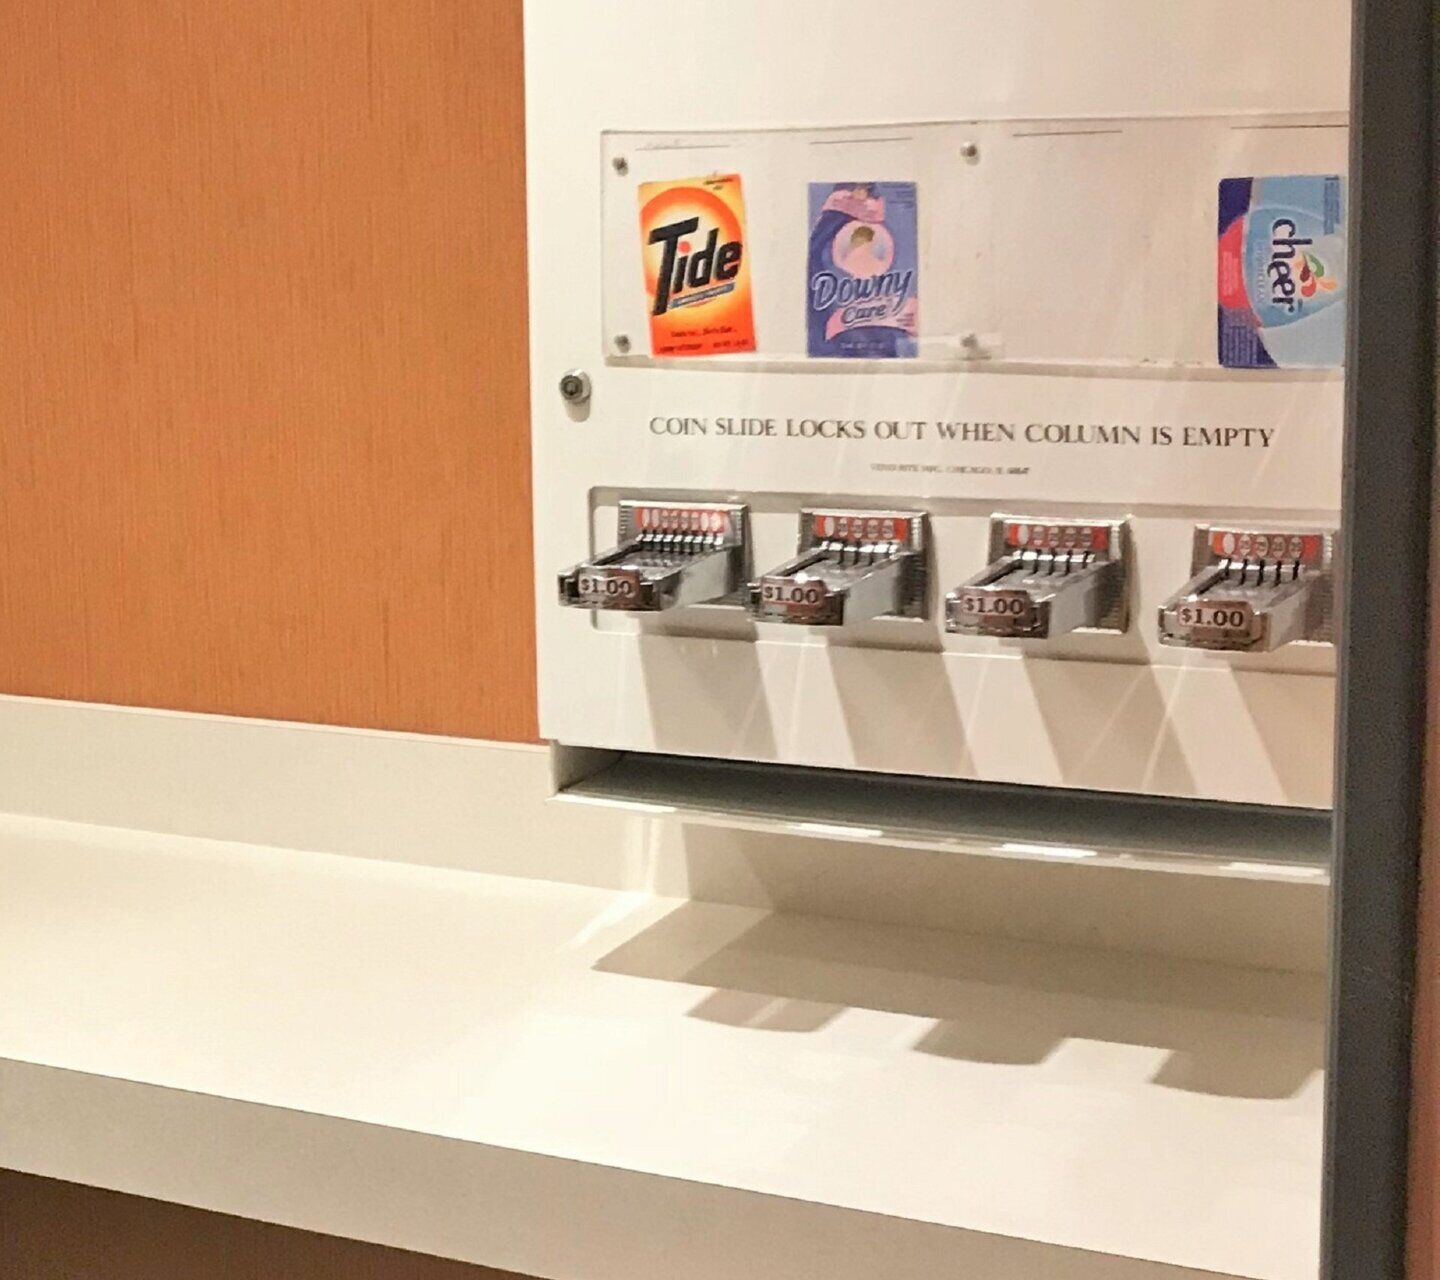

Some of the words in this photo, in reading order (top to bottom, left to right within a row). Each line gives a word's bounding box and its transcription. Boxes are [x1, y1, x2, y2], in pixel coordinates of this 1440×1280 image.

[648, 216, 743, 316] Tide
[1267, 218, 1313, 313] cheer
[812, 269, 912, 316] Downy
[649, 416, 707, 436] COIN
[715, 417, 778, 437] SLIDE
[786, 418, 866, 439] LOCKS
[874, 420, 927, 441] OUT
[937, 422, 1017, 443] WHEN
[1024, 423, 1141, 445] COLUMN
[1151, 426, 1173, 446] IS
[1182, 426, 1275, 448] EMPTY
[581, 577, 633, 596] $1.00
[764, 584, 820, 604] $1.00
[964, 596, 1025, 616] $1.00
[1180, 607, 1244, 628] $1.00
